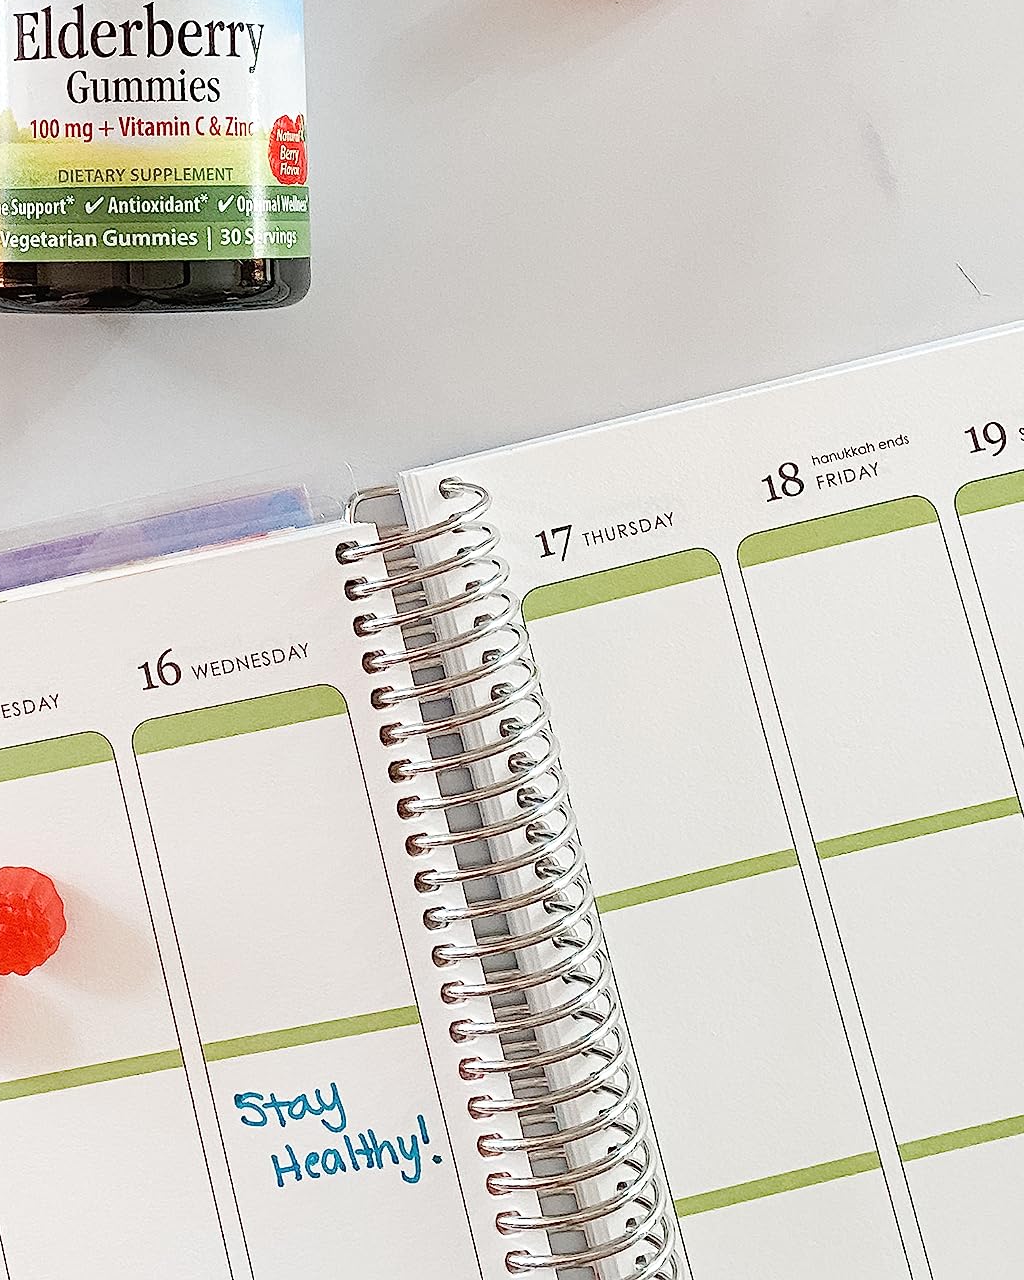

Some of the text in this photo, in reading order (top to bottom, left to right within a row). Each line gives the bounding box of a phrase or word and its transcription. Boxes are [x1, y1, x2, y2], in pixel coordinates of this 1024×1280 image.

[13, 1, 265, 74] Elderberry
[66, 68, 221, 104] Gummies
[30, 118, 60, 139] 100
[64, 122, 93, 143] mg
[98, 120, 116, 137] +
[118, 115, 191, 137] Vitamin
[195, 115, 205, 136] C
[209, 115, 222, 137] &
[279, 144, 300, 165] Berry
[58, 167, 234, 183] DIETARY SUPPLEMENT
[0, 229, 98, 252] Vegetarian
[103, 227, 199, 247] Gummies
[220, 227, 242, 246] 30
[811, 434, 910, 466] hanukkah ends
[964, 421, 1007, 457] 19
[761, 462, 879, 503] 18 FRIDAY
[535, 511, 674, 562] 17 THURSDAY
[137, 642, 310, 691] 16 WEDNESDAY
[234, 1082, 347, 1133] Stay
[271, 1114, 443, 1188] Healthy!
